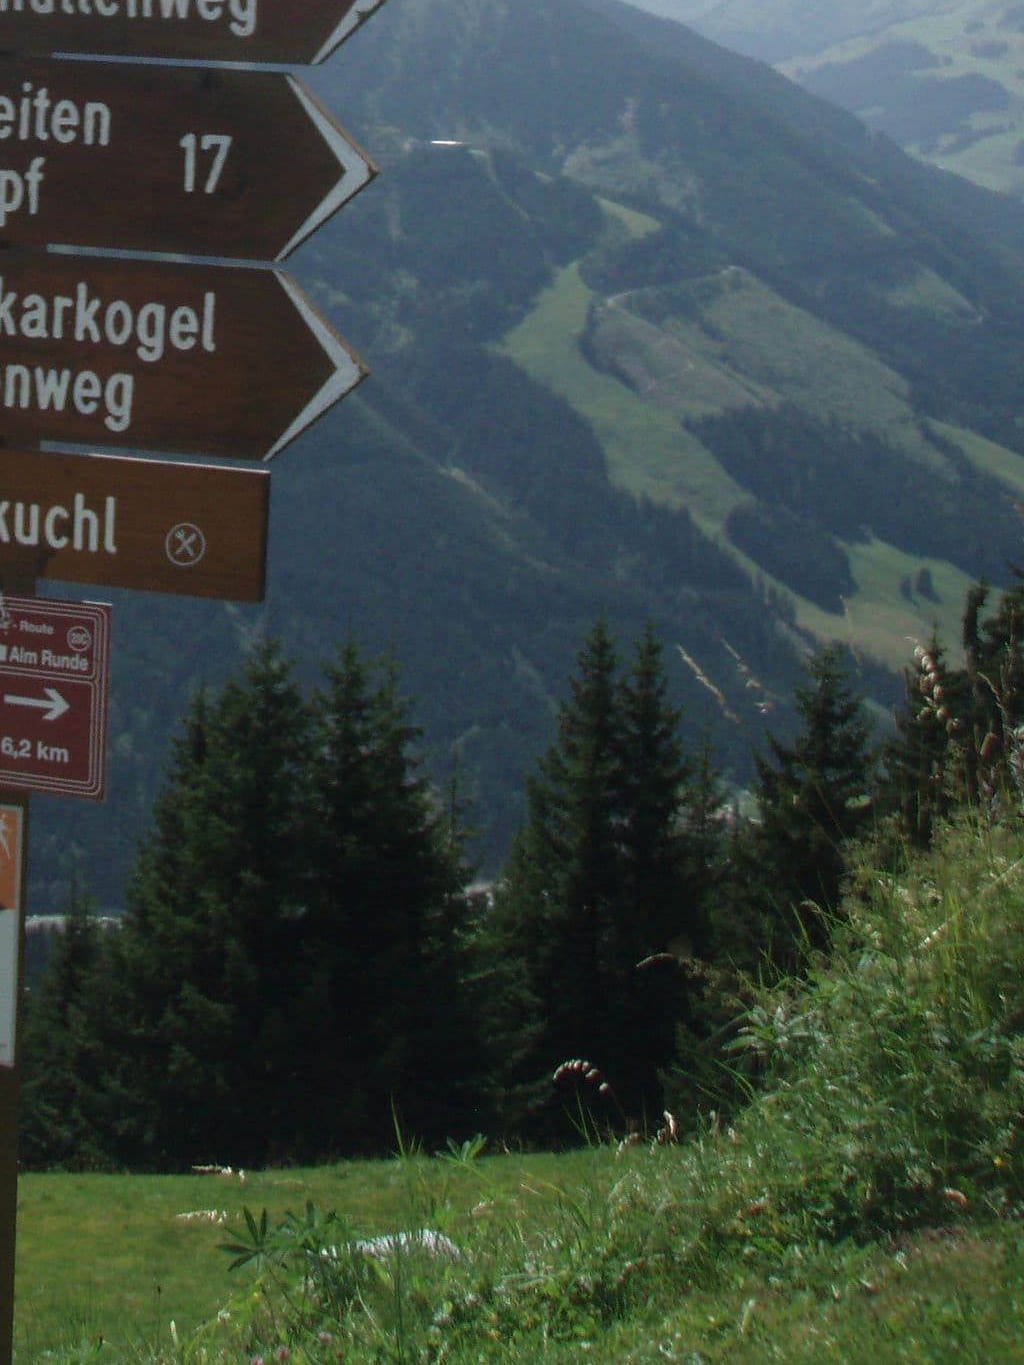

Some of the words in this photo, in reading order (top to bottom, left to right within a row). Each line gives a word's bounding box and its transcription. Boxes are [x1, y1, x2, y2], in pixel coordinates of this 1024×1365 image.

[180, 134, 232, 194] 17
[19, 619, 54, 636] Route
[9, 645, 38, 665] Alm
[41, 651, 89, 671] Runde
[0, 736, 32, 761] 6,2
[37, 740, 70, 764] km
